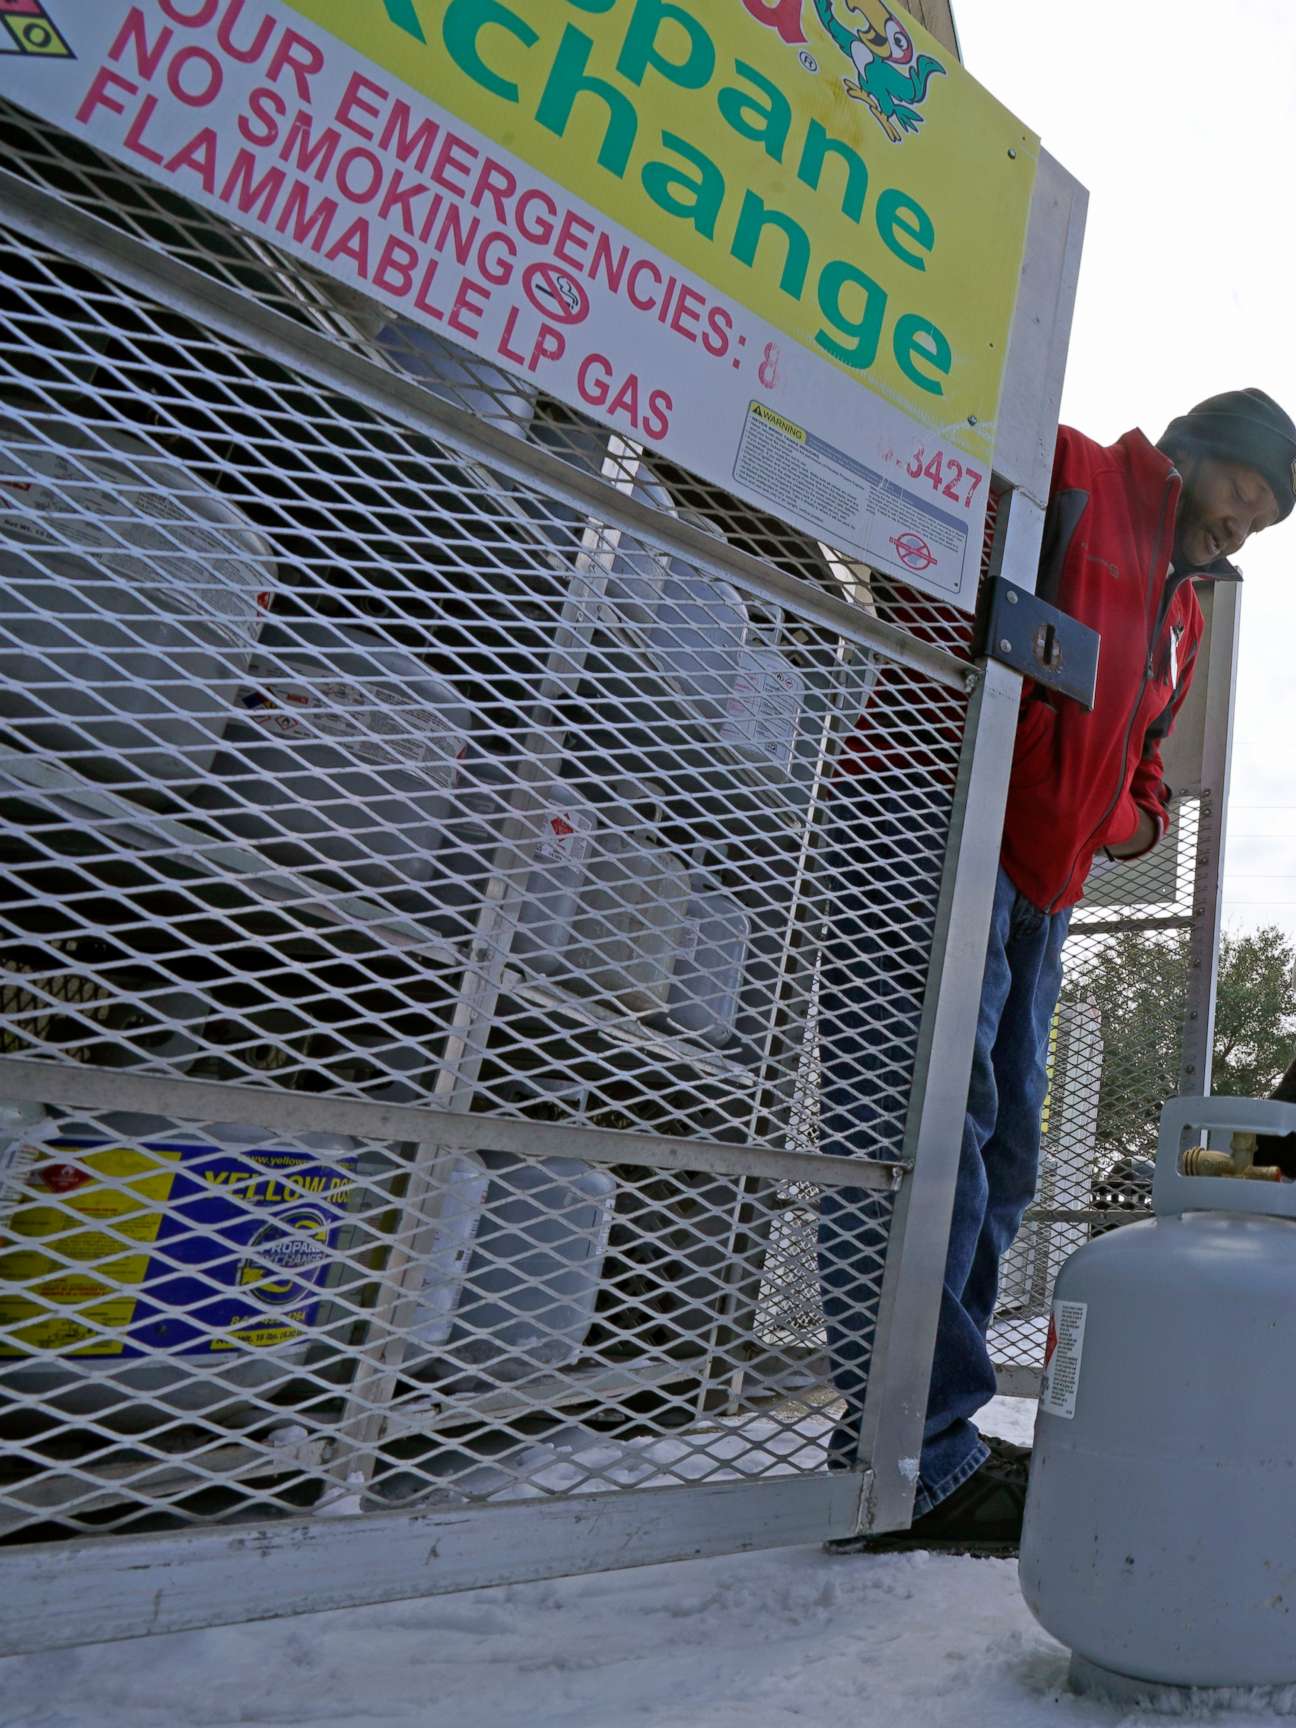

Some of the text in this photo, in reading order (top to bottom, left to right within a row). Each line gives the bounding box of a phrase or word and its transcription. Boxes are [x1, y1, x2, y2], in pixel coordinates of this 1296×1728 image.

[75, 66, 673, 440] FLAMMABLE LP GAS
[107, 5, 517, 285] NO SMOKING
[335, 71, 747, 369] EMERGENCIES:
[383, 0, 952, 397] change
[565, 0, 935, 272] pane
[763, 410, 802, 440] WARNING
